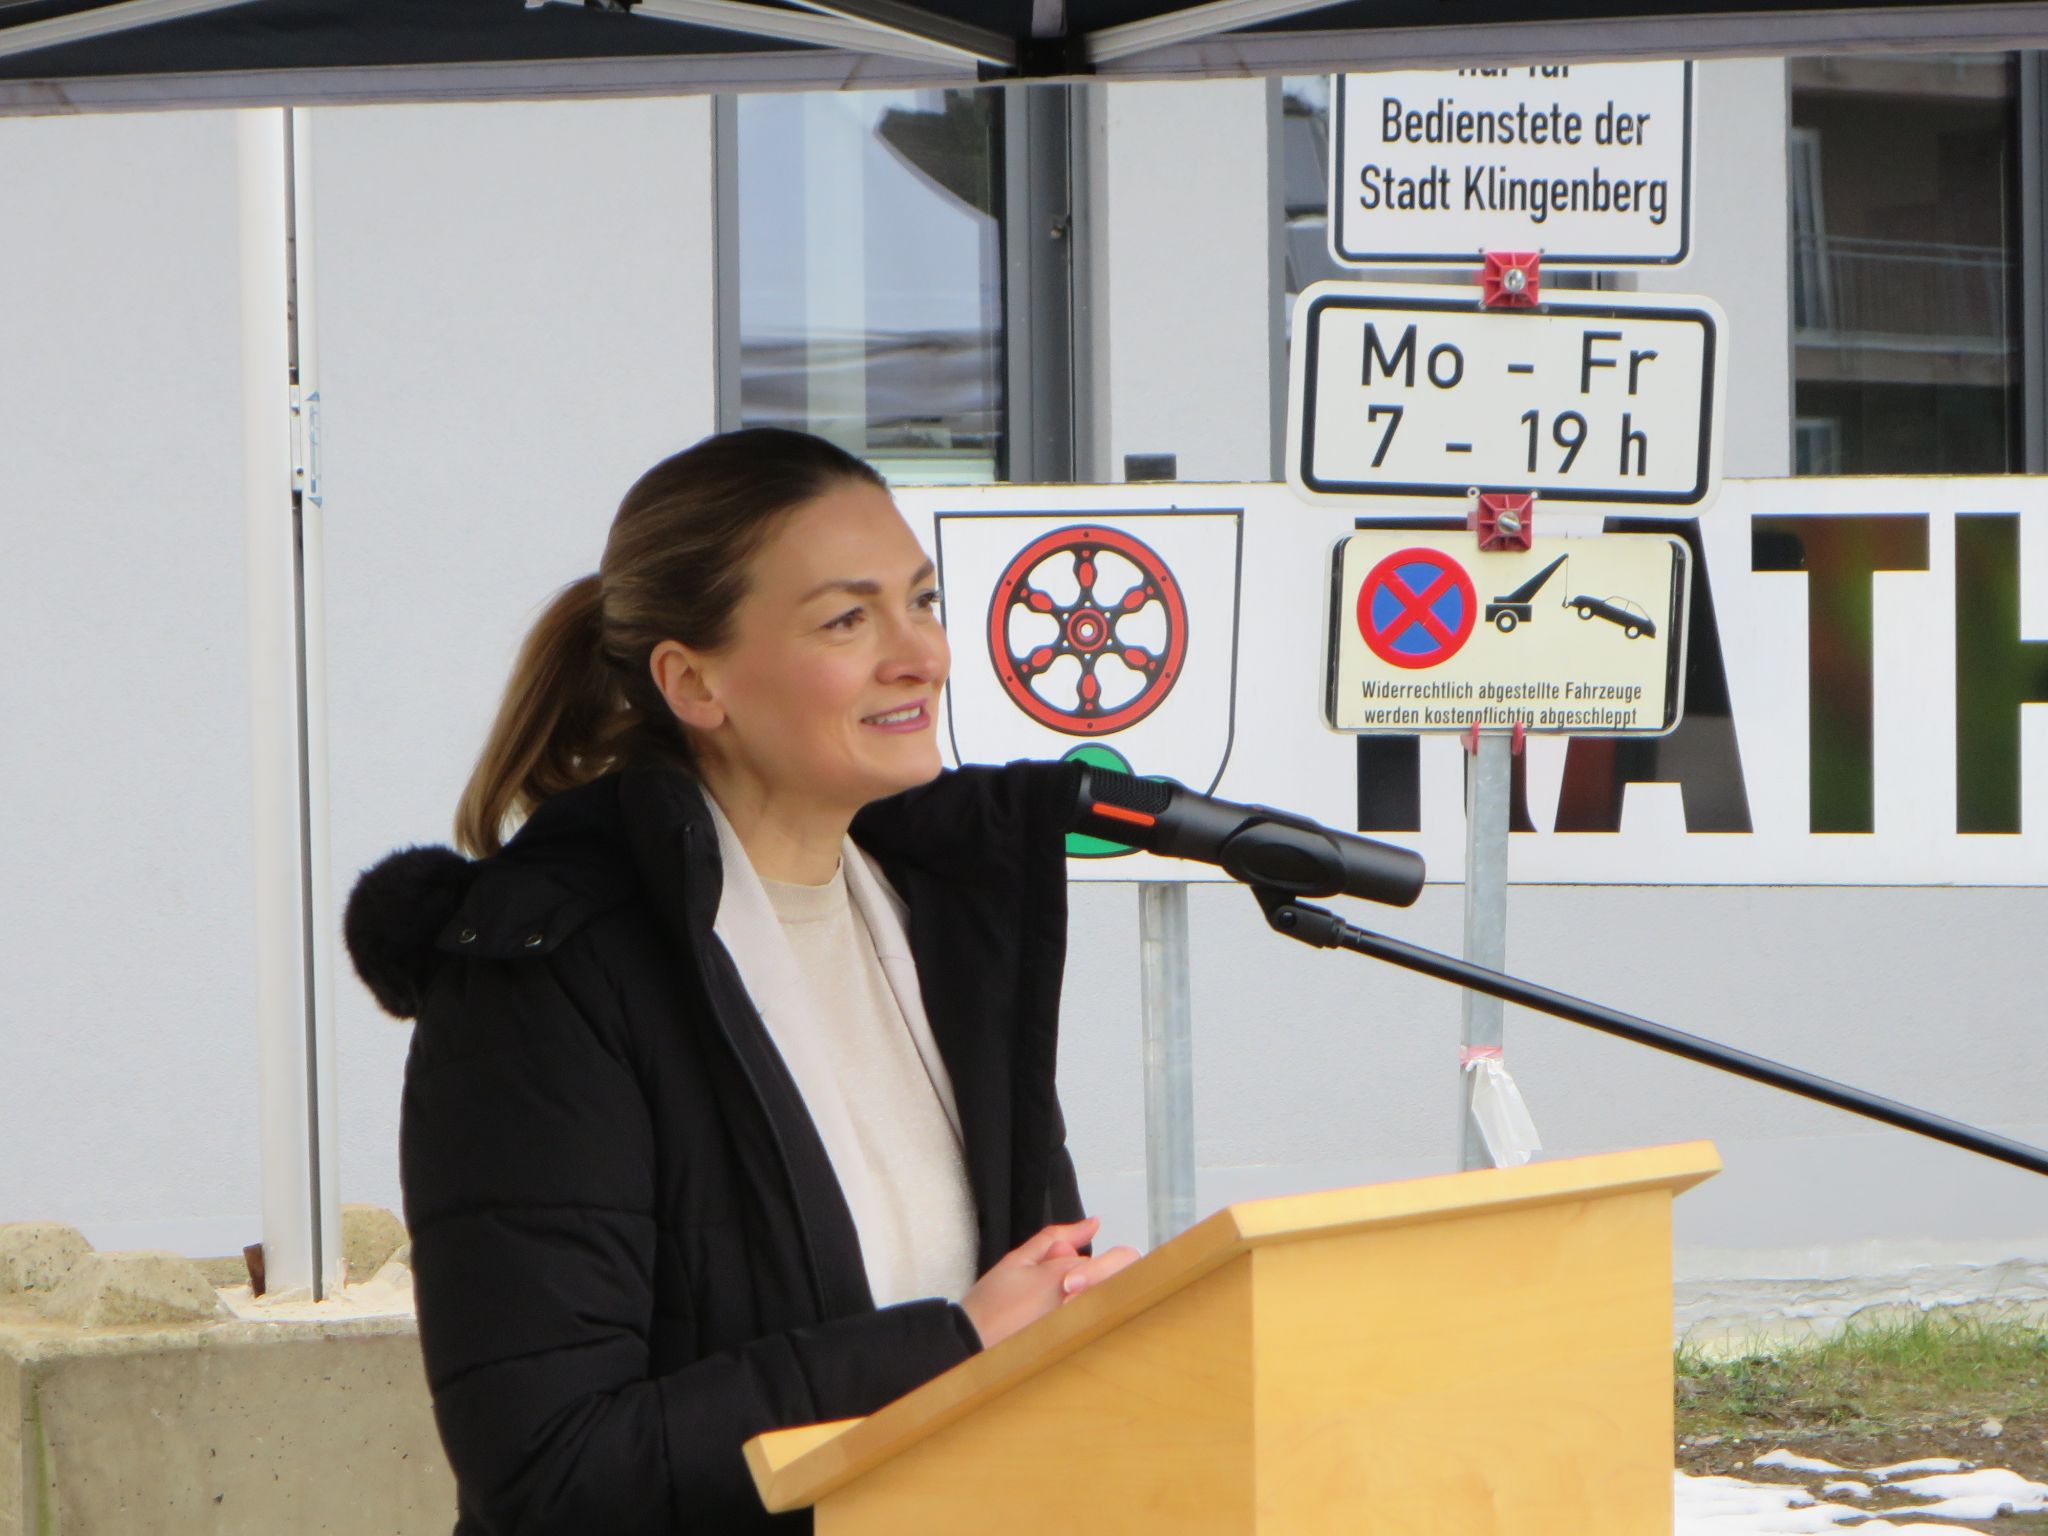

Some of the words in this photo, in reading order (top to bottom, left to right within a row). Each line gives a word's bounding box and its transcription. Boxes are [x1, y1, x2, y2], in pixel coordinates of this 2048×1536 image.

[1382, 97, 1582, 145] Bedienstete
[1595, 101, 1650, 146] der
[1360, 164, 1450, 211] Stadt
[1464, 165, 1668, 225] Klingenberg
[1361, 322, 1465, 390] Mo
[1580, 329, 1659, 396] Fr
[1366, 404, 1404, 468] 7
[1520, 408, 1588, 474] 19
[1619, 412, 1648, 477] h
[1361, 680, 1473, 700] Widerrechtlich
[1478, 681, 1559, 703] abgestellte
[1565, 682, 1642, 704] Fahrzeuge
[1364, 706, 1420, 724] werden
[1424, 706, 1534, 728] kostenpflichtig
[1539, 707, 1637, 729] abgeschleppt
